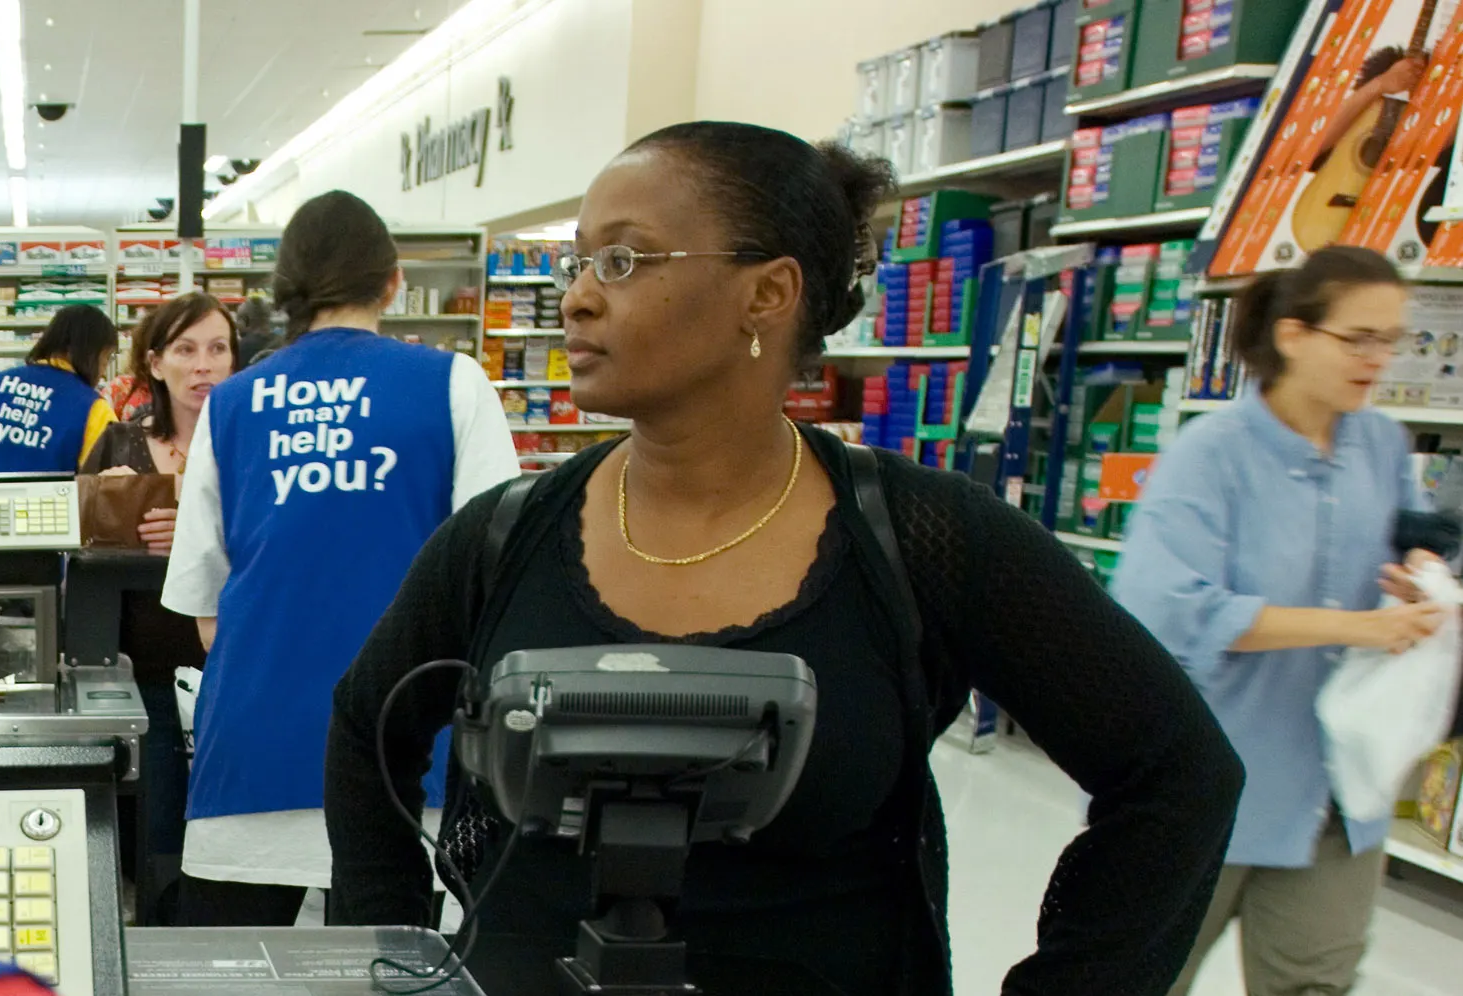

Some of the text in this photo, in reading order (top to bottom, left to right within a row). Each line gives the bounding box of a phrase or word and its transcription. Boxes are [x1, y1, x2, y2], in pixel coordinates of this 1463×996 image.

[416, 106, 491, 188] Pharmacy
[0, 375, 53, 400] How
[13, 396, 52, 411] may I
[251, 374, 367, 413] How
[0, 403, 38, 428] help
[287, 396, 371, 425] may I
[269, 423, 354, 459] help
[271, 446, 398, 505] you?
